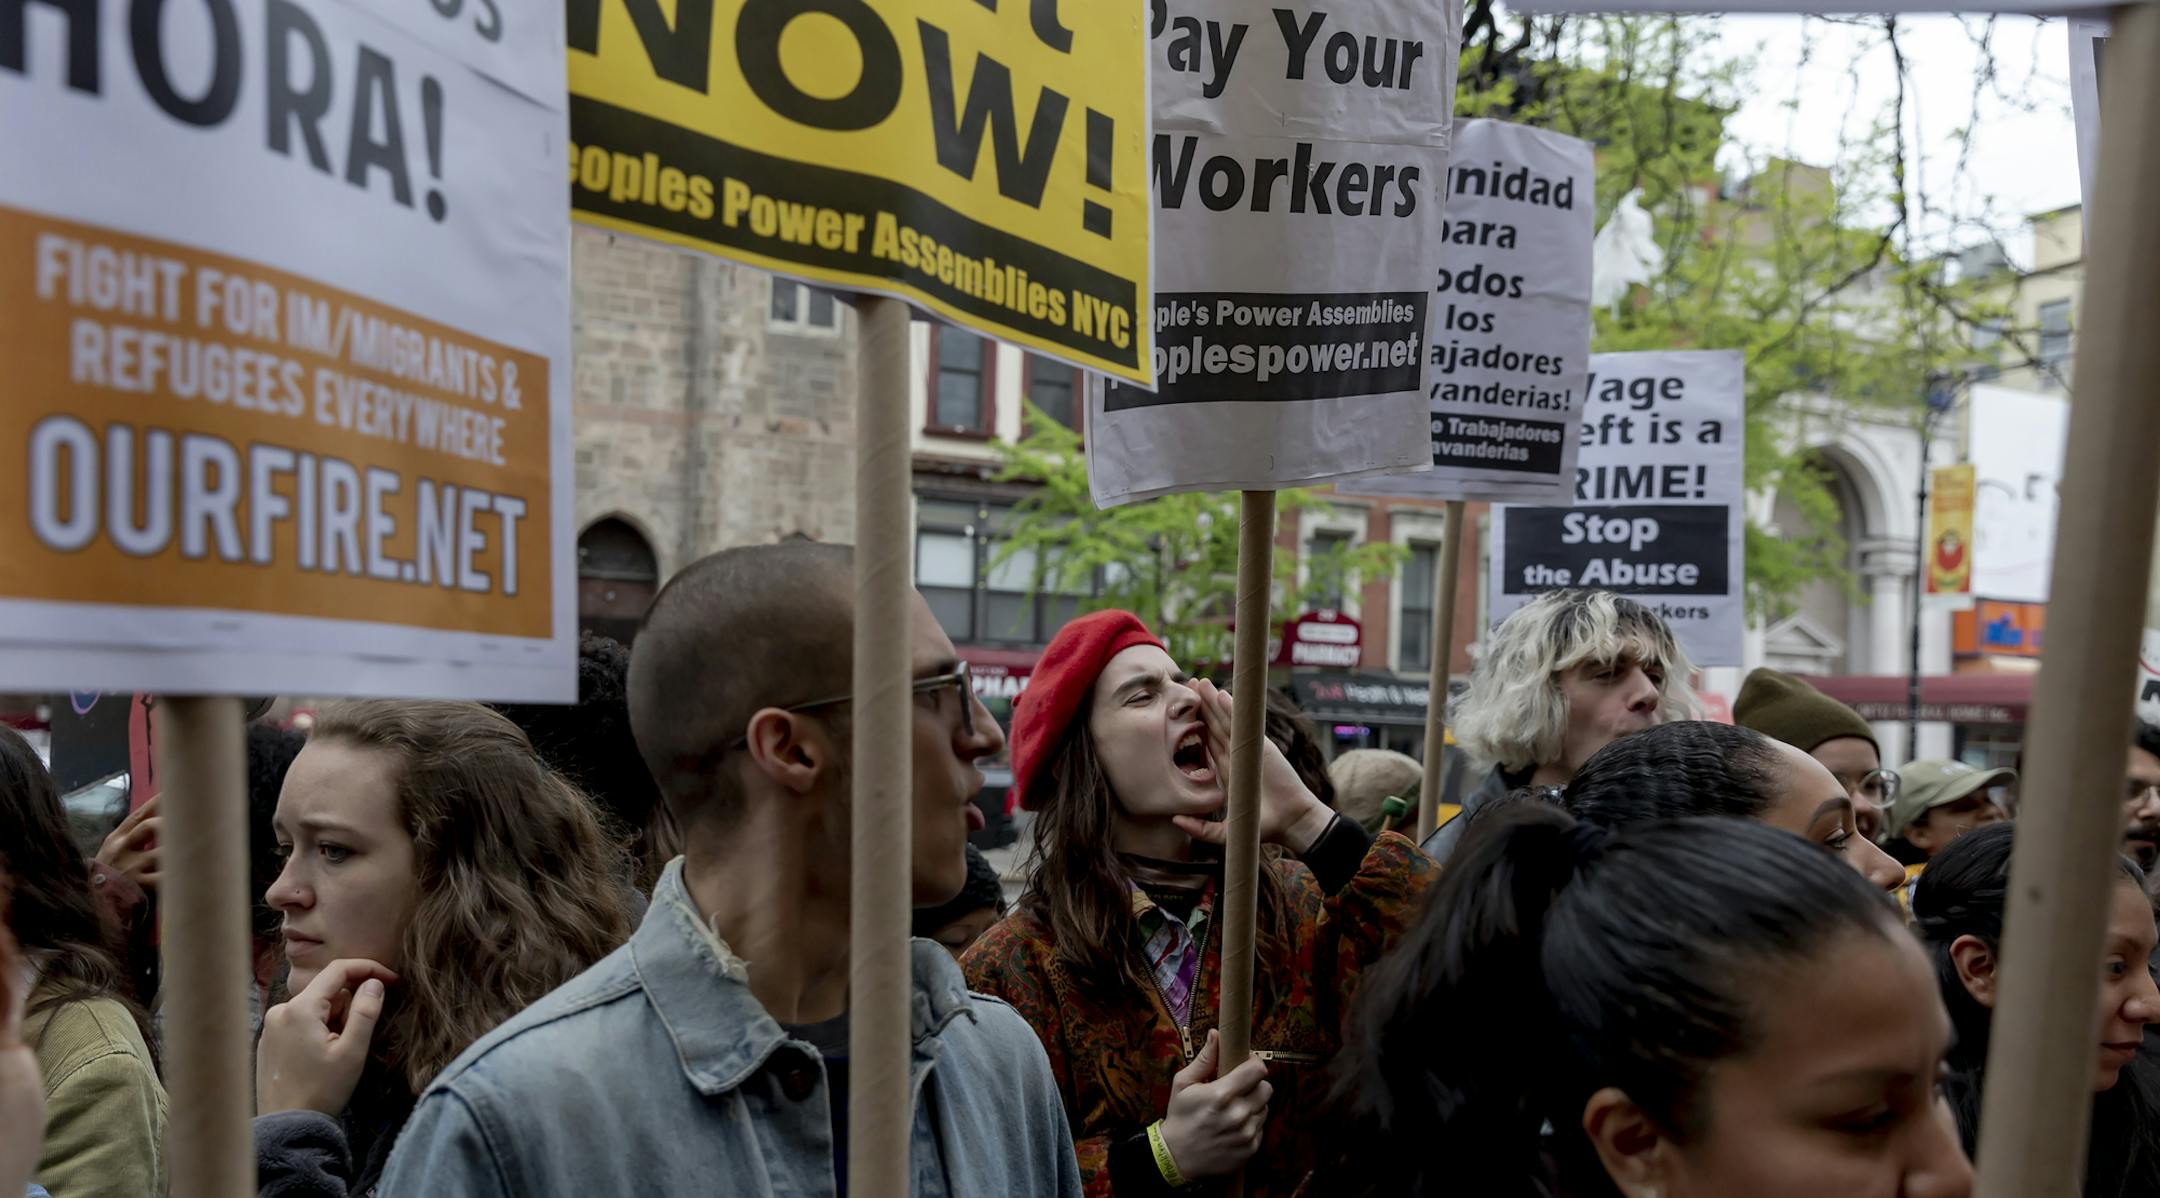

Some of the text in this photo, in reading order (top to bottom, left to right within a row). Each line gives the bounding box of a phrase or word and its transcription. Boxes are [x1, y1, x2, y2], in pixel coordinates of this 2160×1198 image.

[1272, 8, 1424, 90] Your
[1447, 161, 1574, 211] nidad
[722, 177, 865, 254] Power
[871, 211, 1066, 327] Assemblies
[1073, 289, 1131, 349] NYC
[36, 232, 523, 410] FIGHT FOR IM/MIGRANTS &
[1155, 298, 1415, 333] ple's Power Assemblies
[1445, 304, 1495, 333] los
[71, 319, 507, 466] REFUGEES EVERYWHERE
[1584, 372, 1685, 411] age
[1447, 416, 1562, 444] Trabajadores
[1650, 413, 1683, 445] is
[1696, 419, 1722, 445] a
[26, 412, 528, 597] OURFIRE.NET
[1561, 512, 1660, 552] Stop
[1523, 558, 1700, 586] the Abuse
